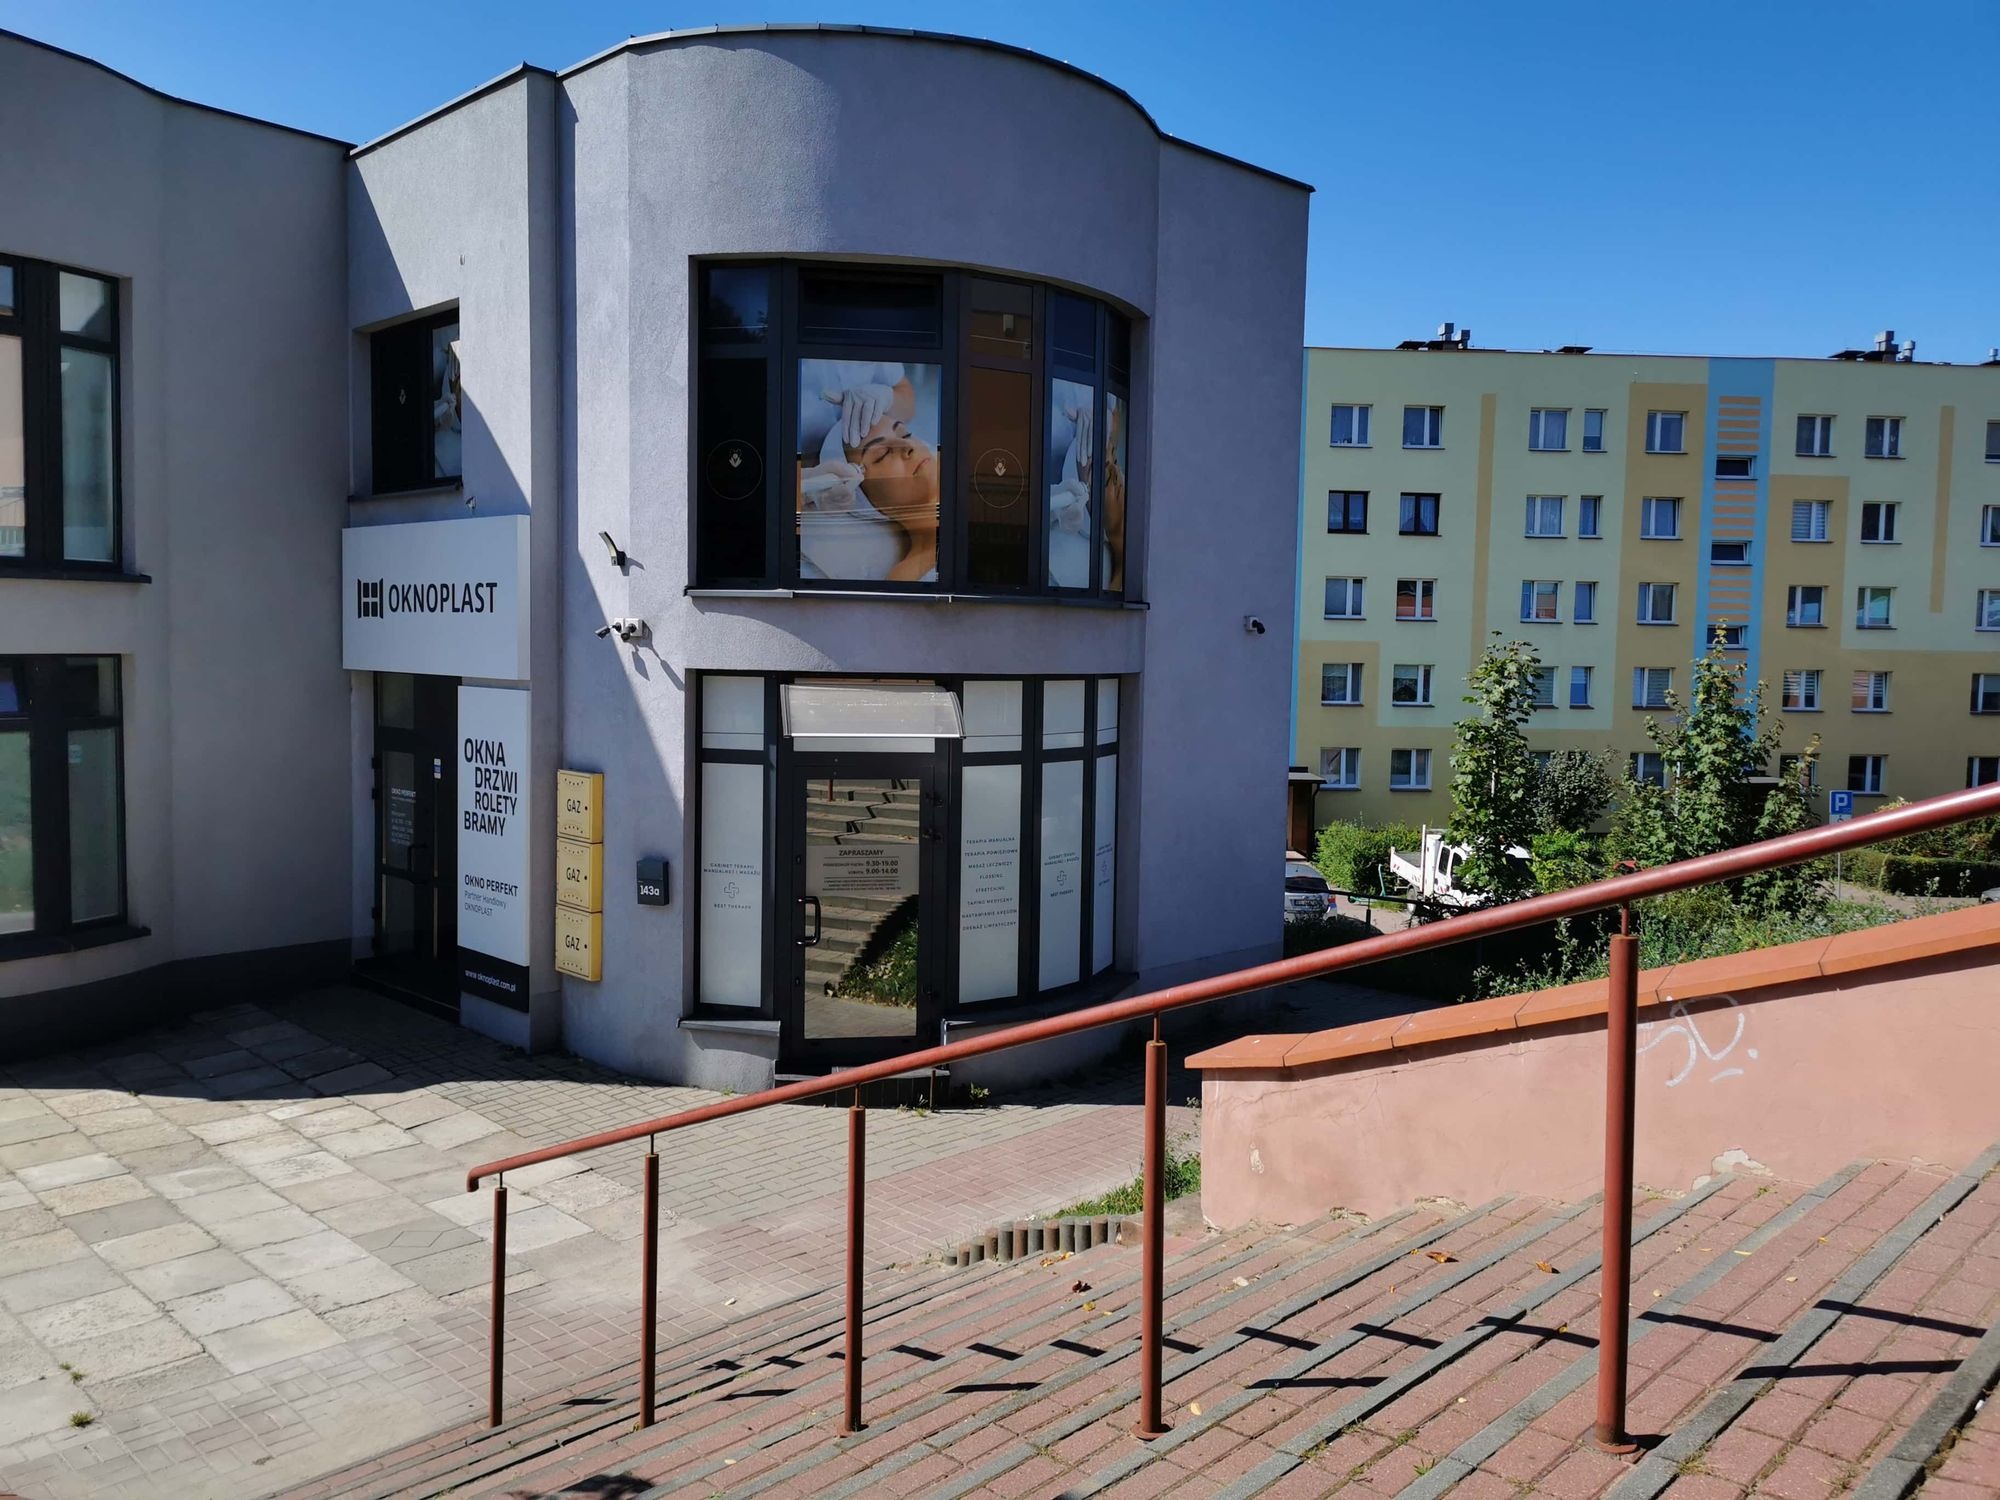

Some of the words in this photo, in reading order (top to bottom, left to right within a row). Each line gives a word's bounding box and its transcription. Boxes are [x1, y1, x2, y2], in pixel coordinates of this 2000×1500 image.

[388, 582, 498, 613] OKNOPLAST
[464, 738, 506, 767] OKNA
[475, 766, 518, 795] DRZWI
[475, 790, 518, 816] ROLETY
[566, 798, 581, 814] GAZ
[1835, 793, 1848, 811] P
[464, 810, 506, 836] BRAMY
[464, 874, 485, 889] OKNO
[486, 879, 519, 897] PERFEKT
[566, 867, 581, 883] GAZ
[640, 885, 660, 896] 143a
[565, 934, 580, 951] GAZ
